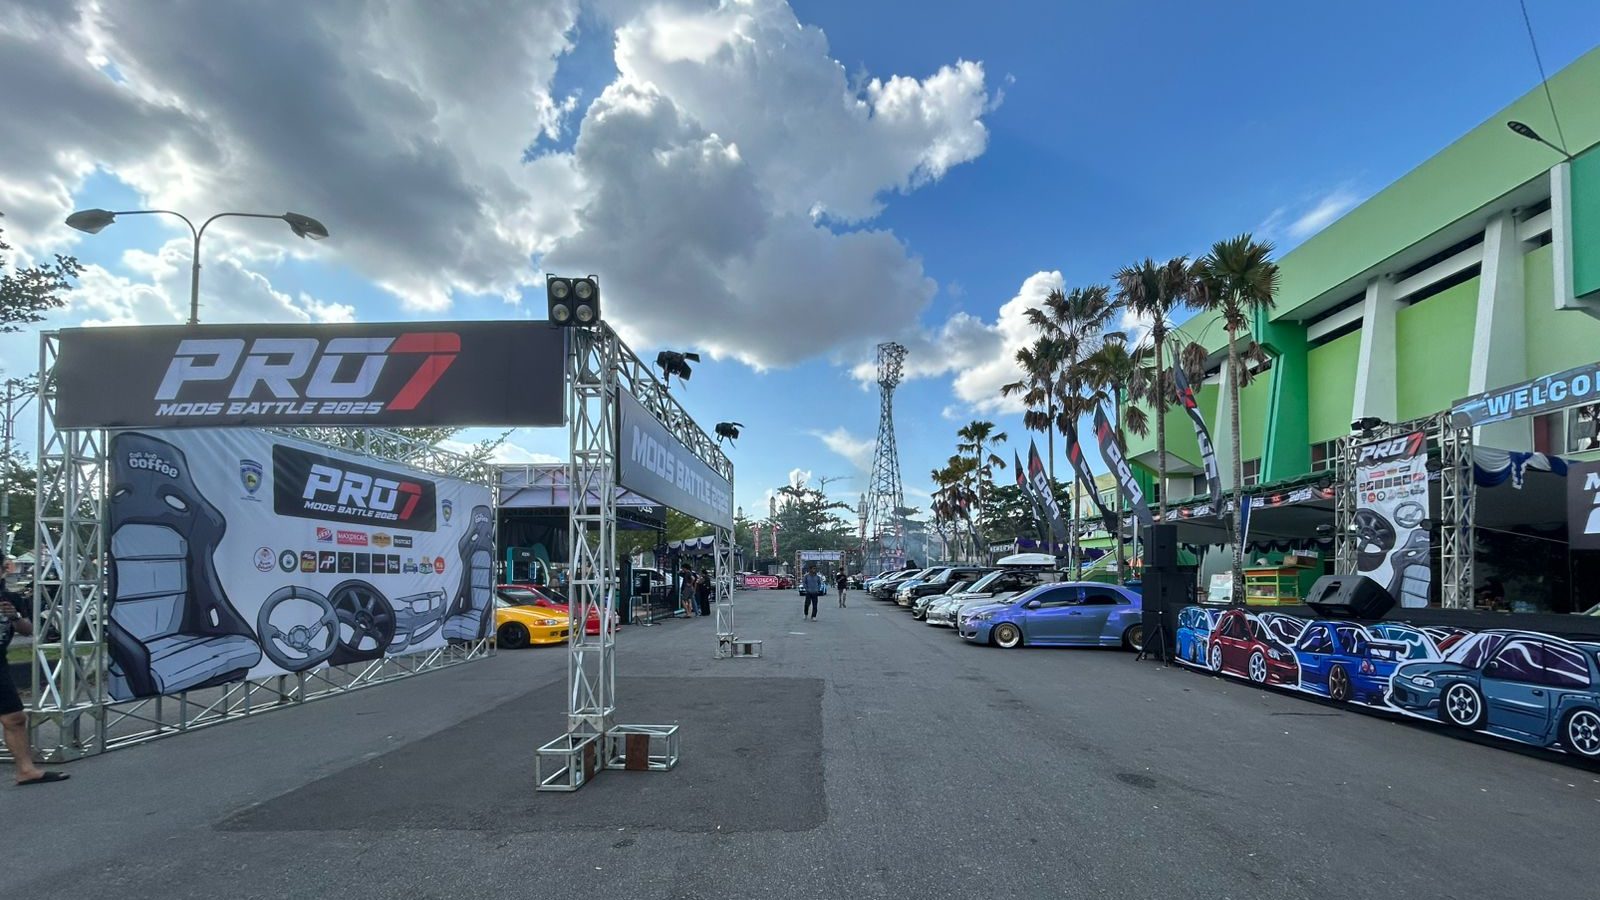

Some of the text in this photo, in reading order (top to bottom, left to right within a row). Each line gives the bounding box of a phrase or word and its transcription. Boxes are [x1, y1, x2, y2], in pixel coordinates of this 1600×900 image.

[1486, 371, 1600, 416] WELCO
[155, 401, 385, 416] MODS BATTLE 2025
[1359, 432, 1424, 462] PRO7
[129, 457, 178, 478] coffee
[632, 425, 674, 483] MODS
[677, 459, 711, 505] BATTLE
[304, 501, 399, 521] MODS BATTLE 2025
